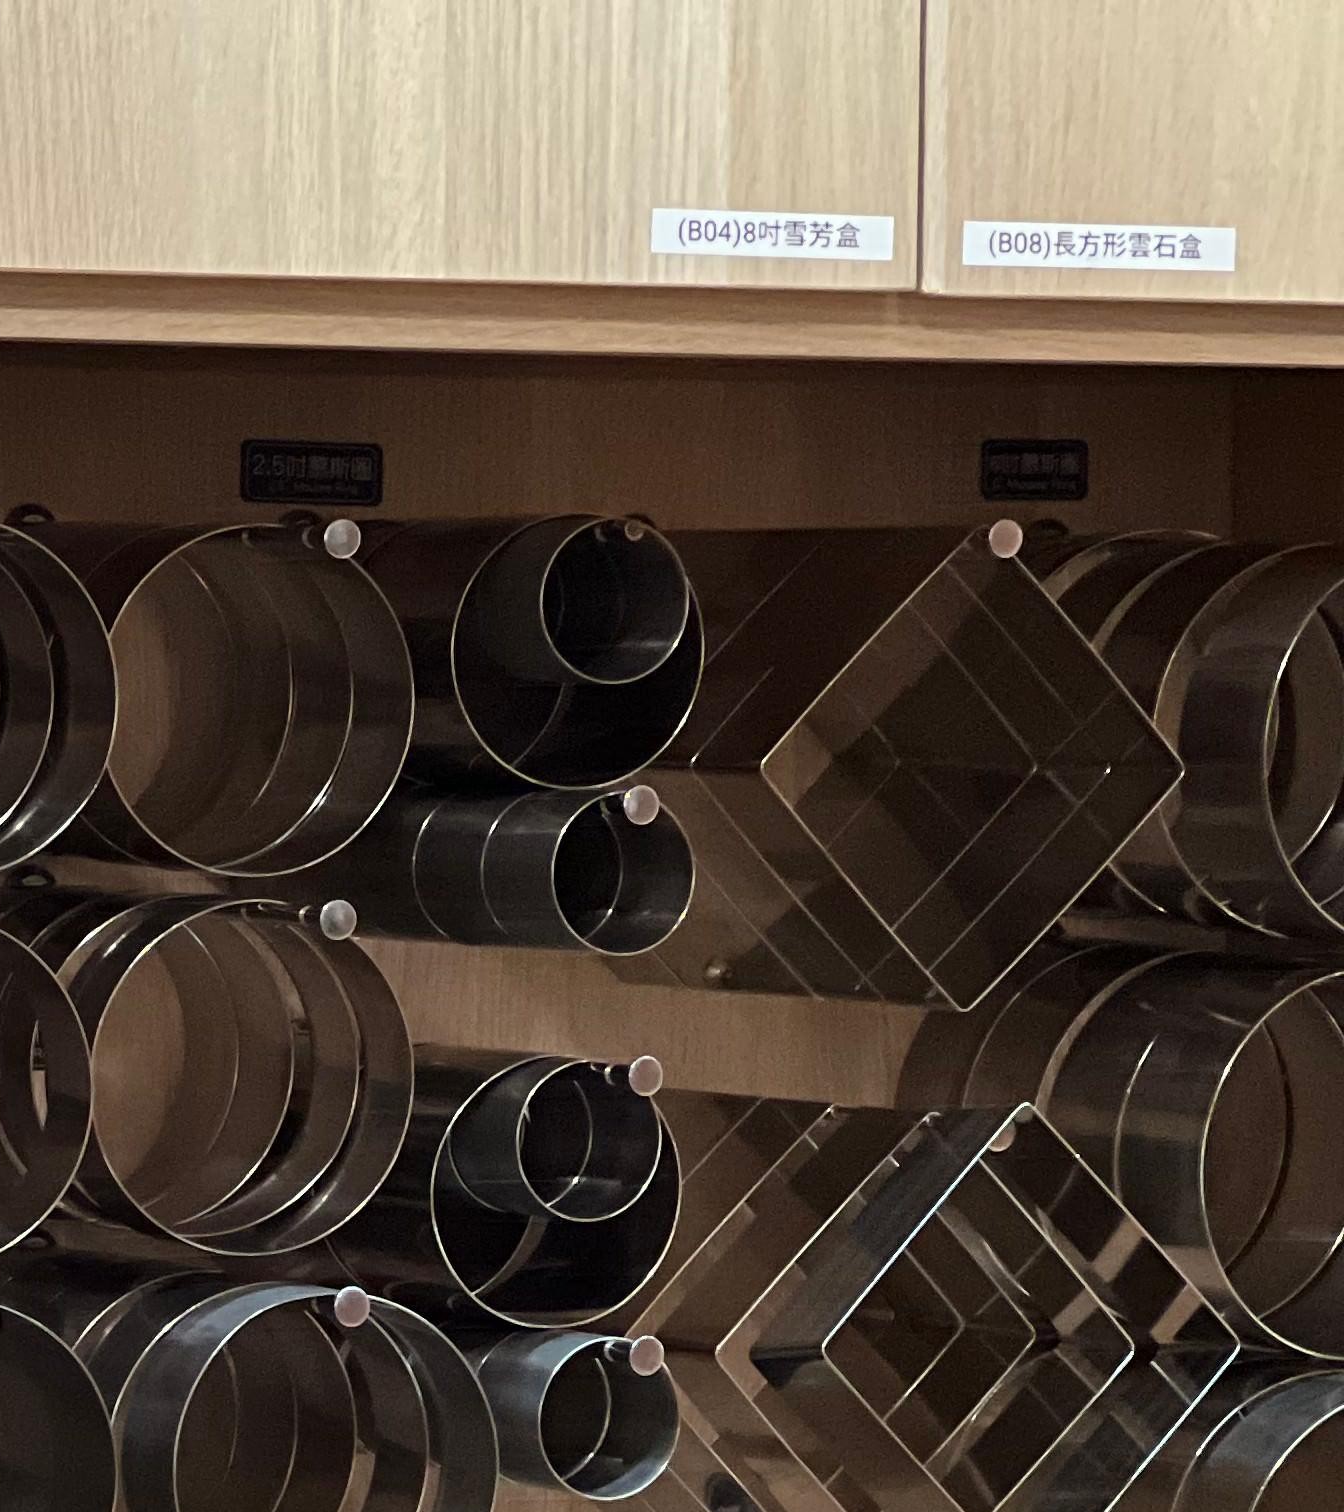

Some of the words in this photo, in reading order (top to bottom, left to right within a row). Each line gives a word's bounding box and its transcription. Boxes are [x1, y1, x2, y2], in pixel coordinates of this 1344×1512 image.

[678, 217, 861, 248] (B04)8吋雪芳盒
[988, 230, 1203, 260] (B08)長方形雲石盒
